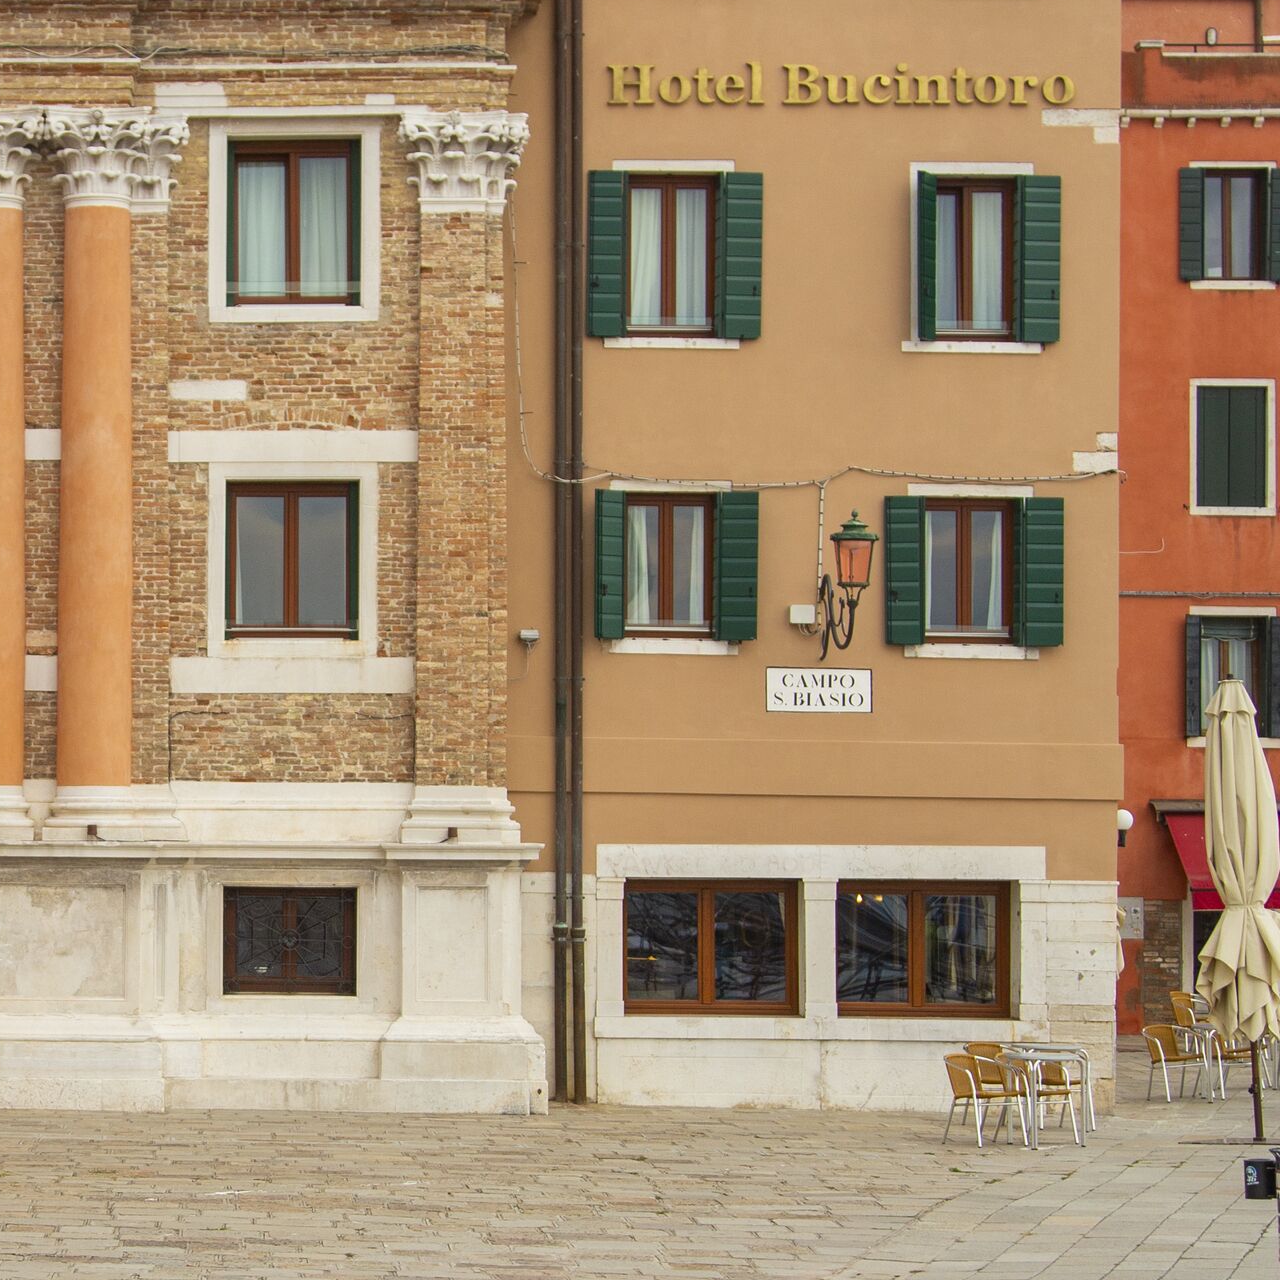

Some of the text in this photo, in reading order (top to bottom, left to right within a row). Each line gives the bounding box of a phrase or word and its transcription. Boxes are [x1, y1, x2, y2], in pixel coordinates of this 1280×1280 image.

[607, 61, 1076, 105] Hotel Bucintoro
[782, 673, 855, 689] CAMPO
[773, 692, 864, 707] S. BIASIO
